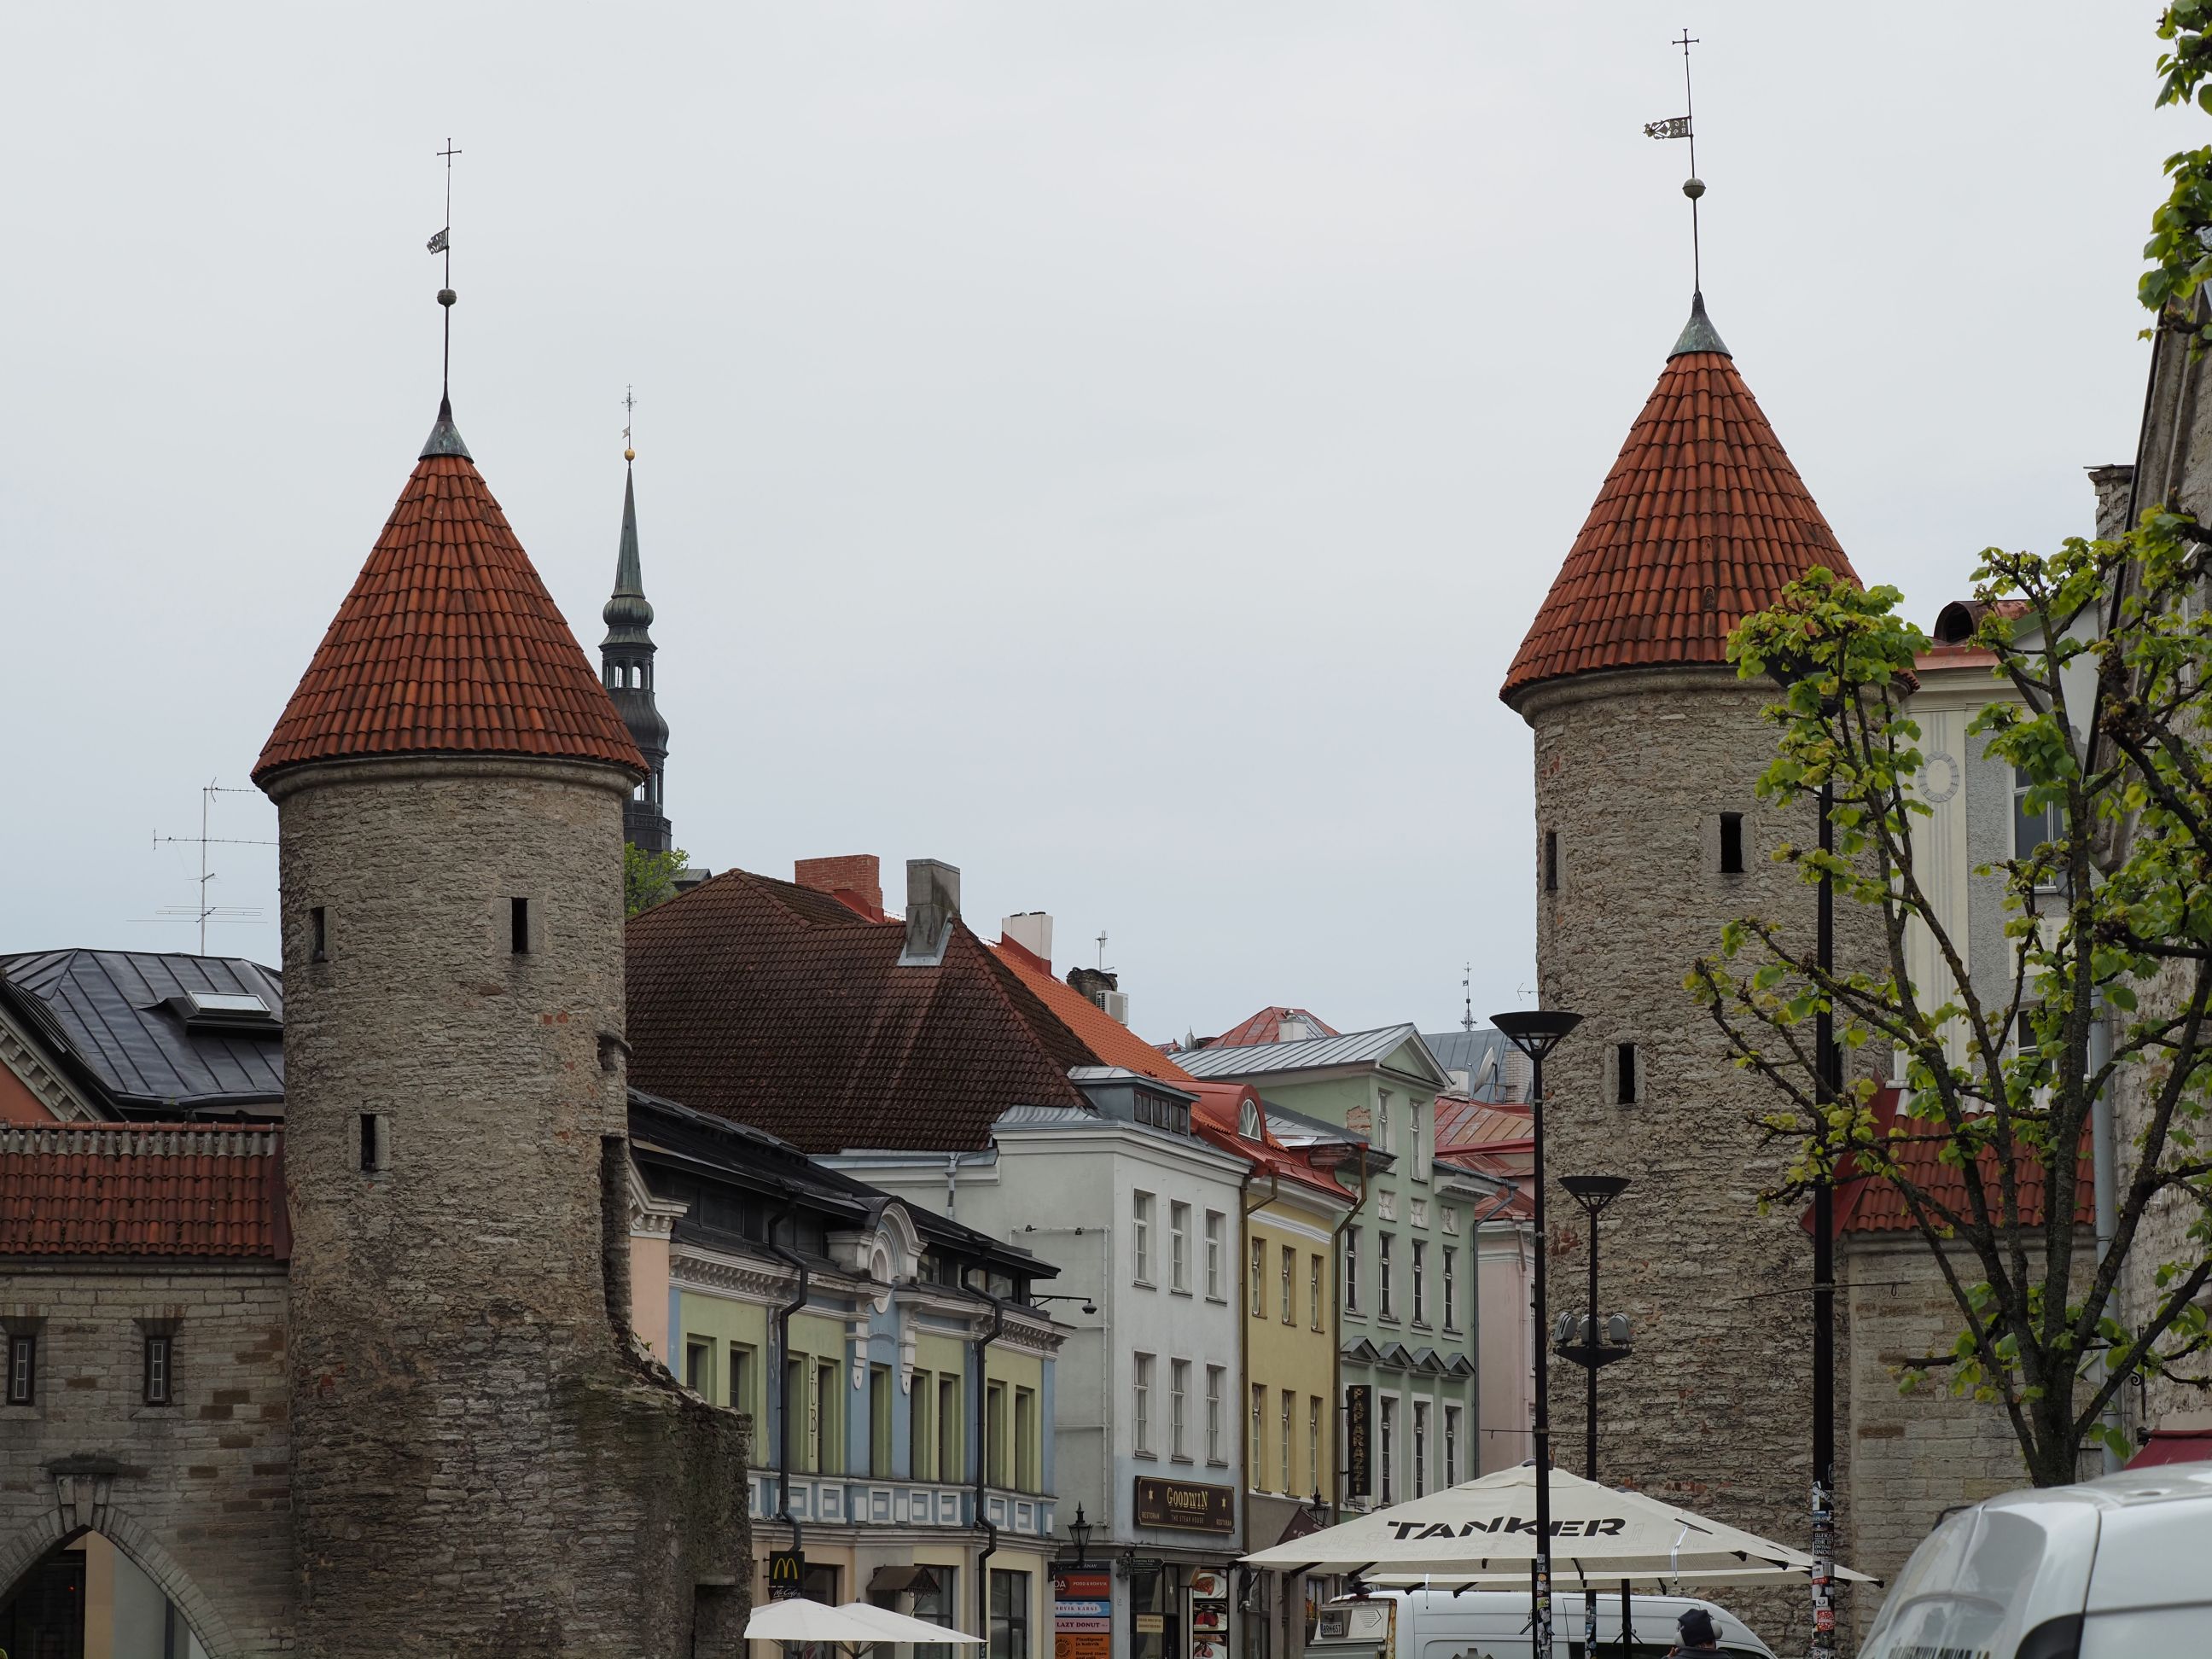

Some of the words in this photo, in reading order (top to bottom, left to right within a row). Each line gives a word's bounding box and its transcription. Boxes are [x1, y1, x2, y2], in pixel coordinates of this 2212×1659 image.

[809, 1356, 818, 1458] PUBI
[1353, 1388, 1365, 1494] PAPARAZZI
[1167, 1487, 1209, 1511] GOODWIN
[1215, 1518, 1232, 1527] RESTORAN
[1387, 1516, 1627, 1540] TANKER
